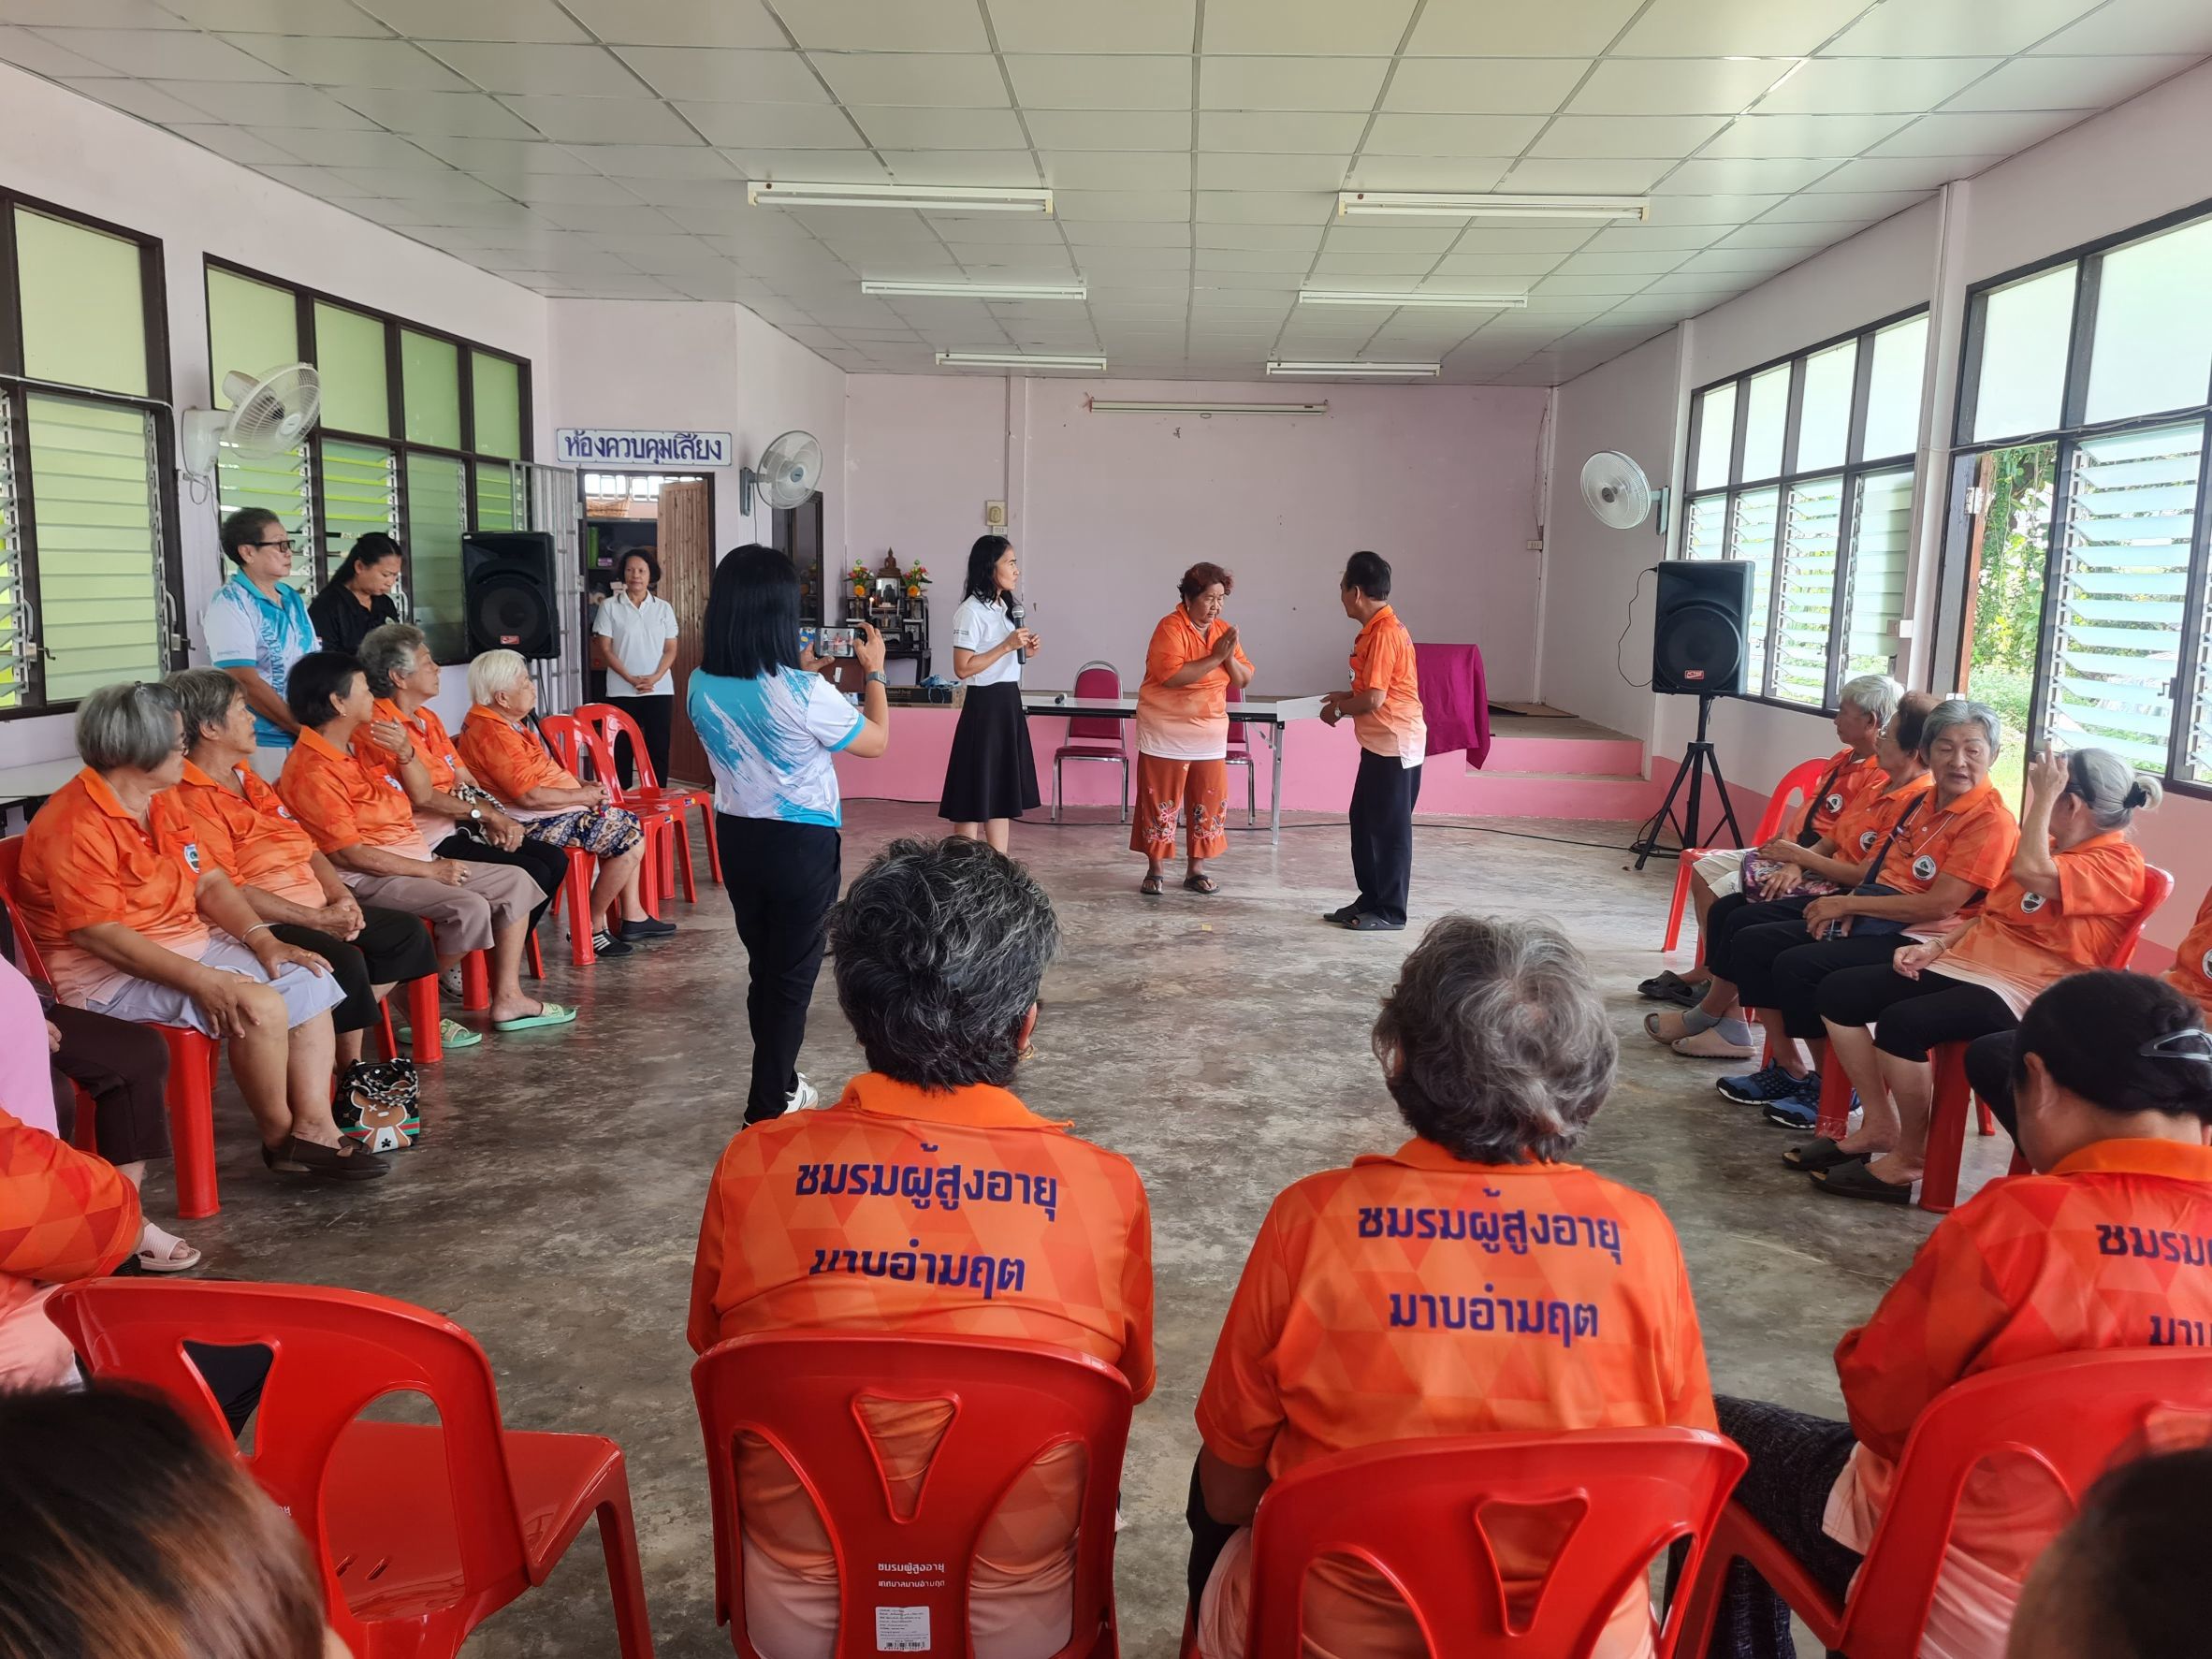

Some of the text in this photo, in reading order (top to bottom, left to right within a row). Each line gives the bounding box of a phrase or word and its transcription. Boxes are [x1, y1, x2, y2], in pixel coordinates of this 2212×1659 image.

[564, 429, 722, 464] ห้องควบคุมเสียง
[795, 1142, 1057, 1222] ชมรมผู้สูงอายุ
[1358, 1187, 1623, 1265] ชมรมผู้สูงอายุ
[2095, 1224, 2212, 1267] ชมรม
[808, 1238, 1026, 1300] มาบอำมฤต
[1389, 1282, 1598, 1348] มาบอำมฤต
[878, 1562, 945, 1574] ชมรมผู้สูงอายุ
